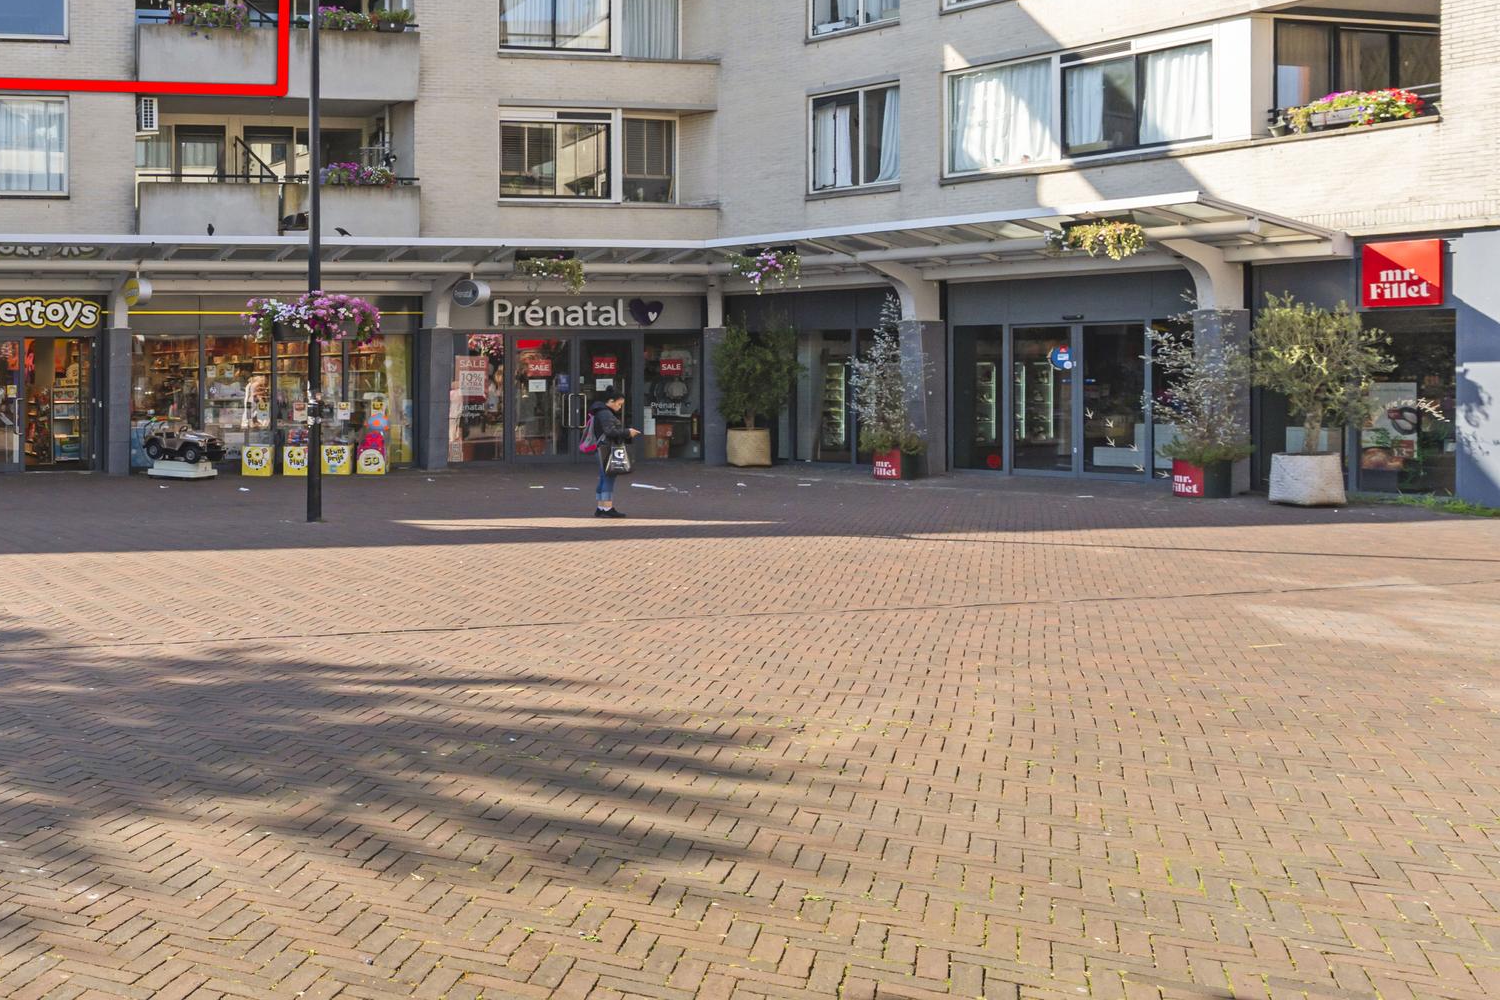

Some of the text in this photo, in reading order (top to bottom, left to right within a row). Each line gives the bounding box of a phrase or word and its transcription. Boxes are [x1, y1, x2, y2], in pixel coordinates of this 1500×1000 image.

[1379, 268, 1419, 282] mr.
[1369, 280, 1431, 300] Fillet
[493, 298, 627, 327] Prénatal
[460, 360, 485, 368] SALE
[661, 363, 682, 371] SALE
[1174, 474, 1192, 483] mr.
